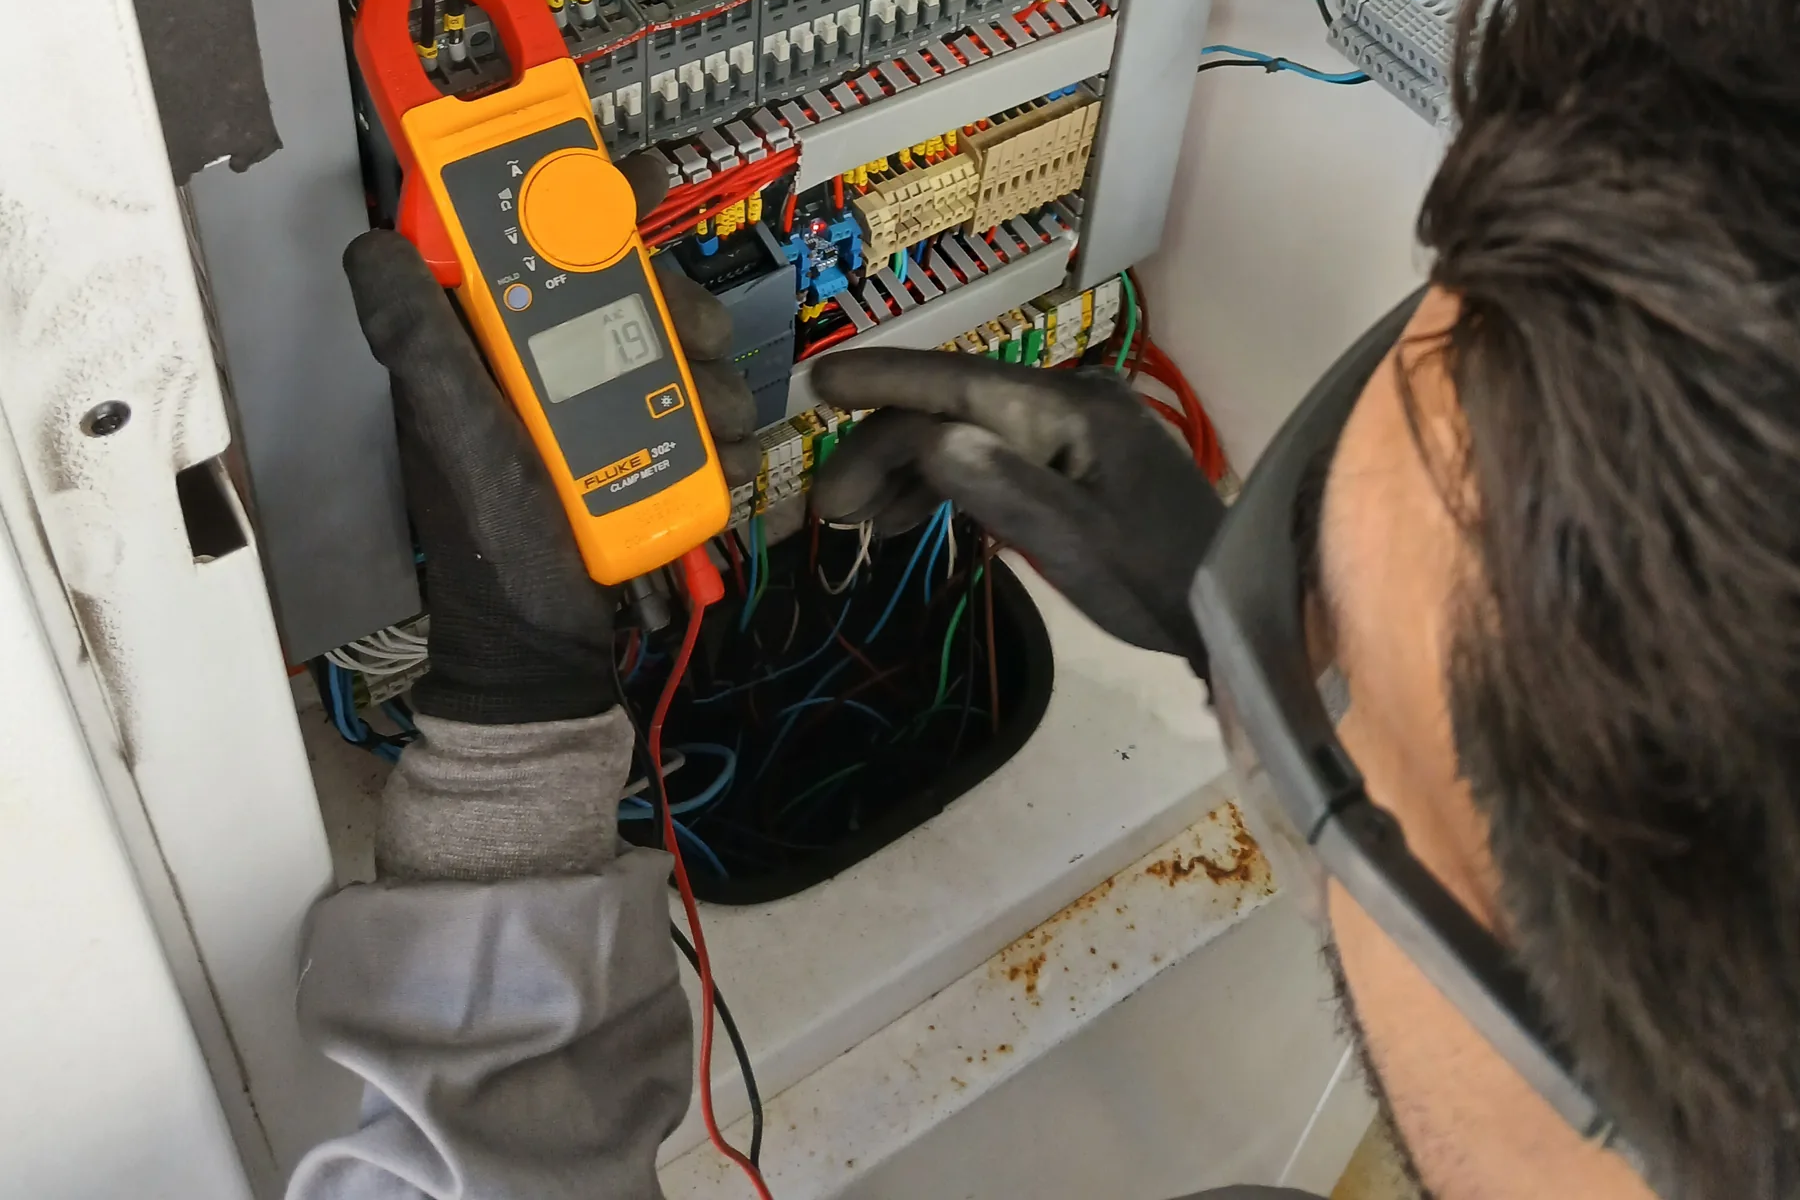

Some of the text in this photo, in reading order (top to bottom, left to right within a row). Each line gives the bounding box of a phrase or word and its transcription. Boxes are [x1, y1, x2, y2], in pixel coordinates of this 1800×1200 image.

[653, 23, 672, 31] ABB
[497, 272, 520, 286] HOLD
[545, 274, 568, 289] OFF
[584, 441, 677, 490] FLUKE 302+
[610, 459, 670, 493] CLAMP METER
